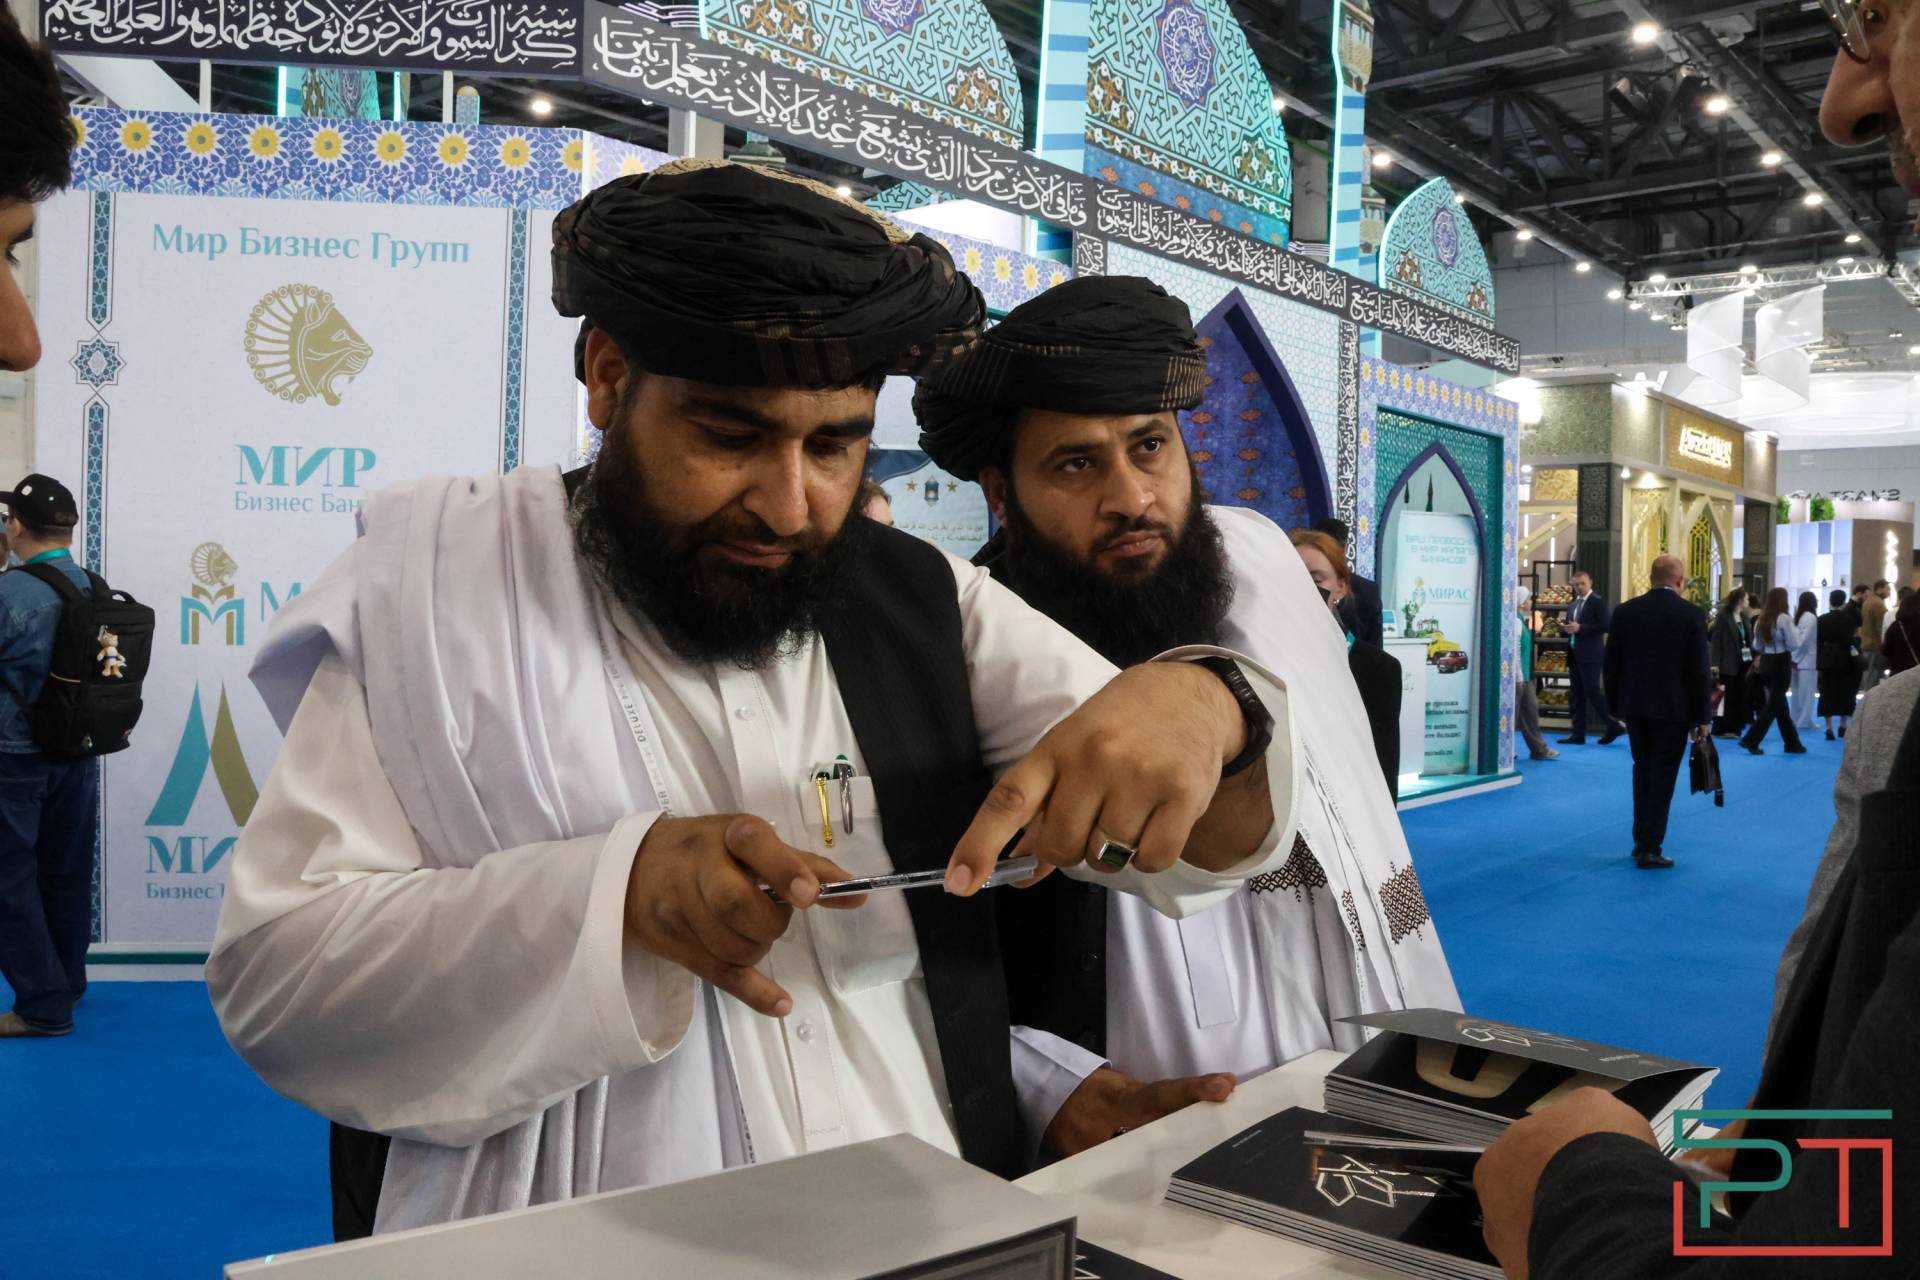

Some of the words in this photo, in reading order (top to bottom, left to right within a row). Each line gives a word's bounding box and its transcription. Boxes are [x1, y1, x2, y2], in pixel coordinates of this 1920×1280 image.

[152, 223, 228, 261] Мир
[239, 227, 360, 259] Бизнес
[371, 232, 470, 269] Групп
[235, 444, 376, 488] МИР
[235, 491, 312, 512] Бизнес
[321, 493, 361, 513] Бан
[624, 702, 647, 743] DELUXE
[144, 836, 238, 874] МИ
[146, 882, 216, 900] Бизнес
